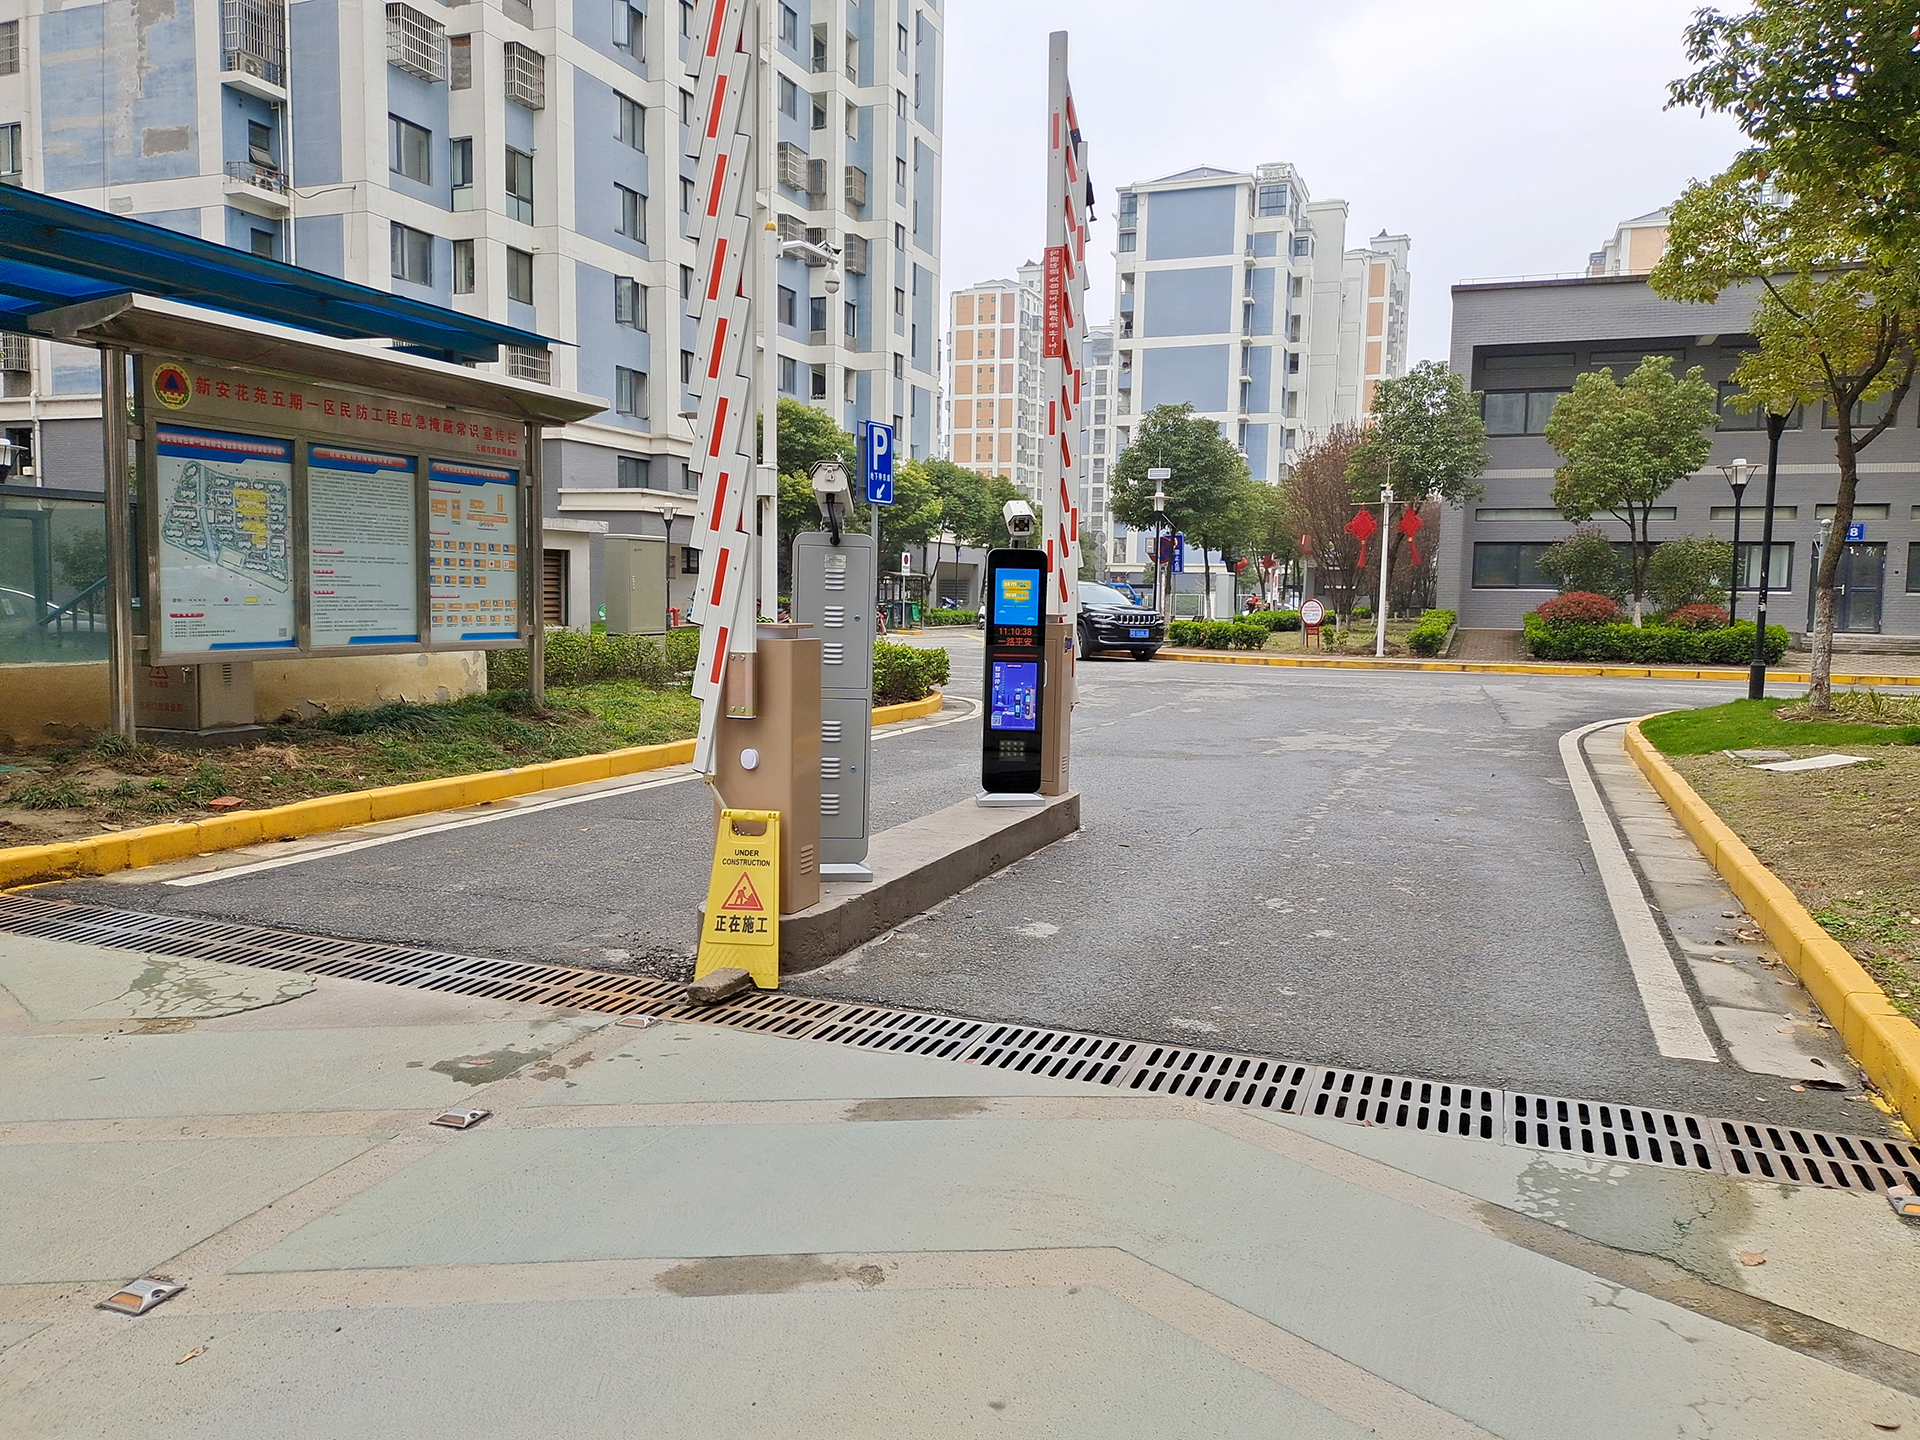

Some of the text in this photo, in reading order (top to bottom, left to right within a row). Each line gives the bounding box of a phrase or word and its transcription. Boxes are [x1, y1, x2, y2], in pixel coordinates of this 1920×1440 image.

[195, 376, 517, 444] 新安花苑五期一区民防工程应急掩蔽常识宣传栏
[873, 427, 888, 470] P
[998, 627, 1033, 636] 11:10:38
[997, 637, 1033, 647] 一路平安
[734, 849, 759, 857] UNDER
[722, 858, 771, 867] CONSTRUCTION
[714, 914, 768, 933] 正在施工
